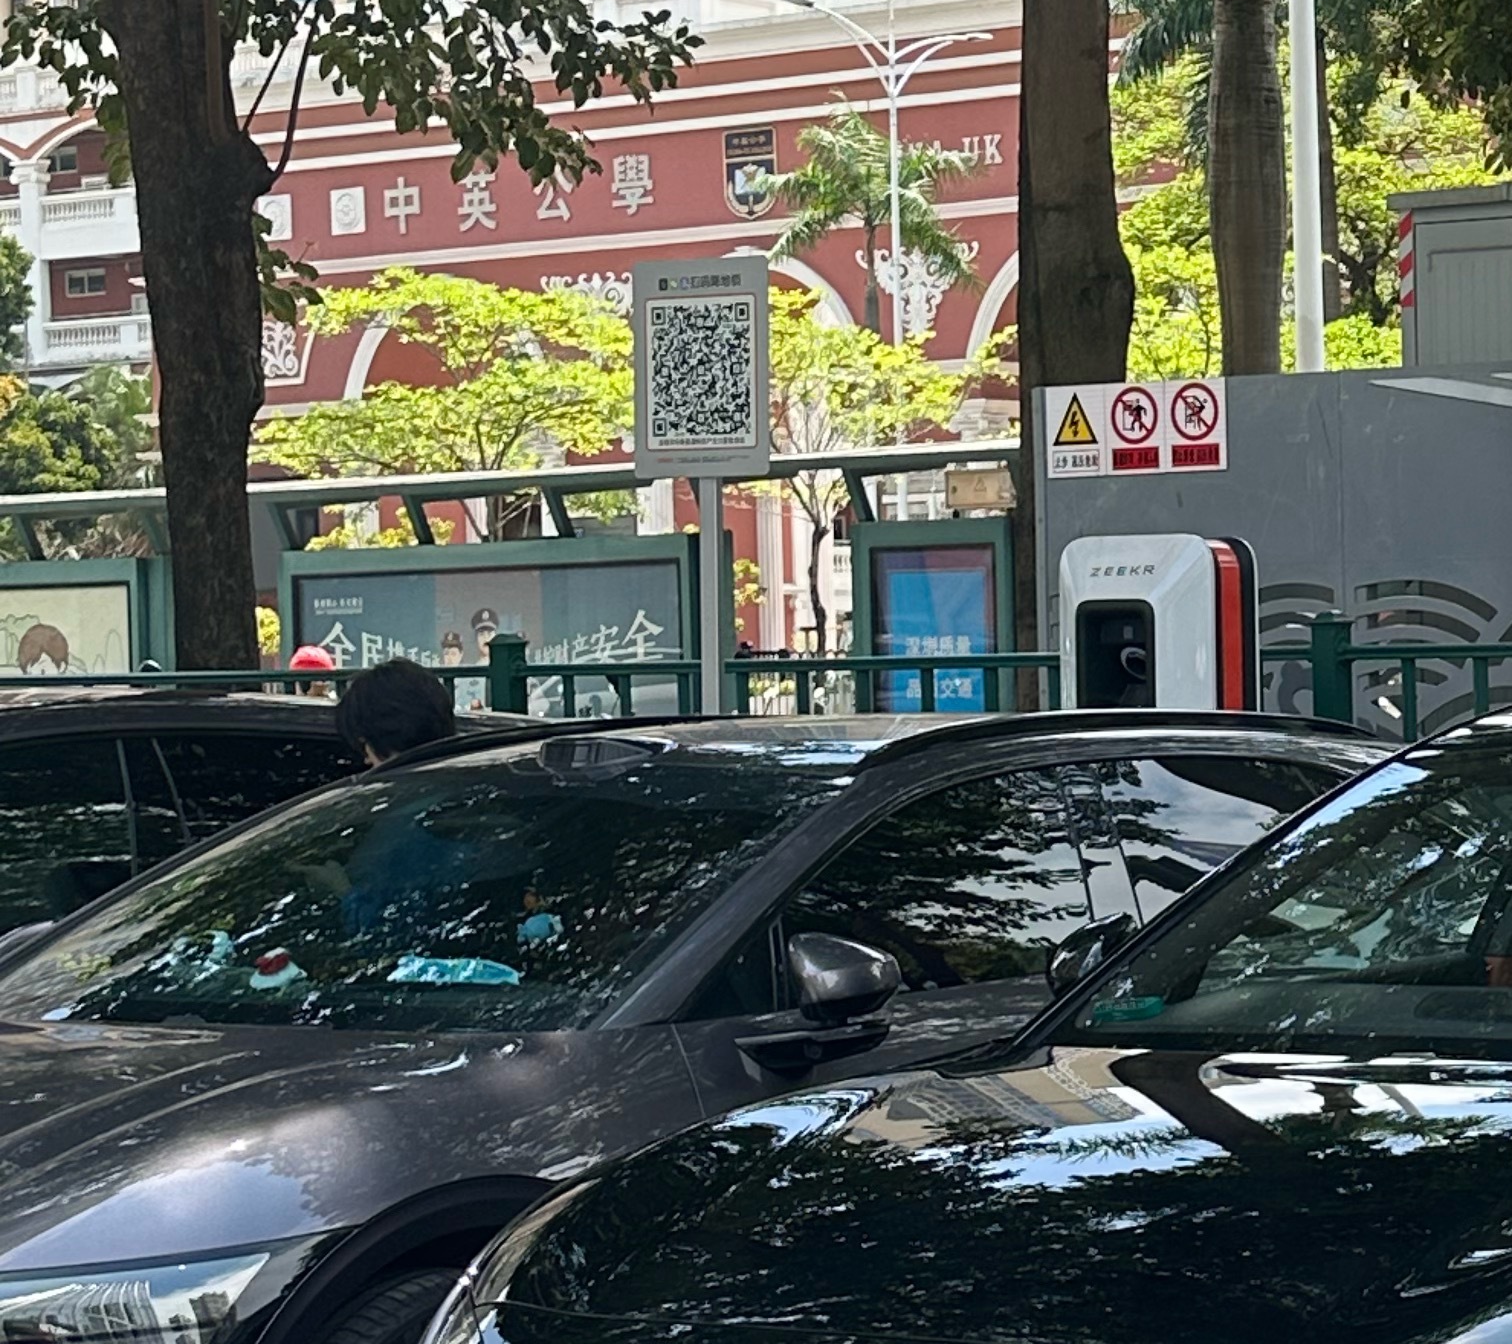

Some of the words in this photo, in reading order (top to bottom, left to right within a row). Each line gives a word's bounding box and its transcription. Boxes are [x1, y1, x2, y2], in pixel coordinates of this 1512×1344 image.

[383, 153, 655, 235] 中英公學
[1089, 564, 1156, 578] ZEEKR
[906, 677, 973, 699] 品交通
